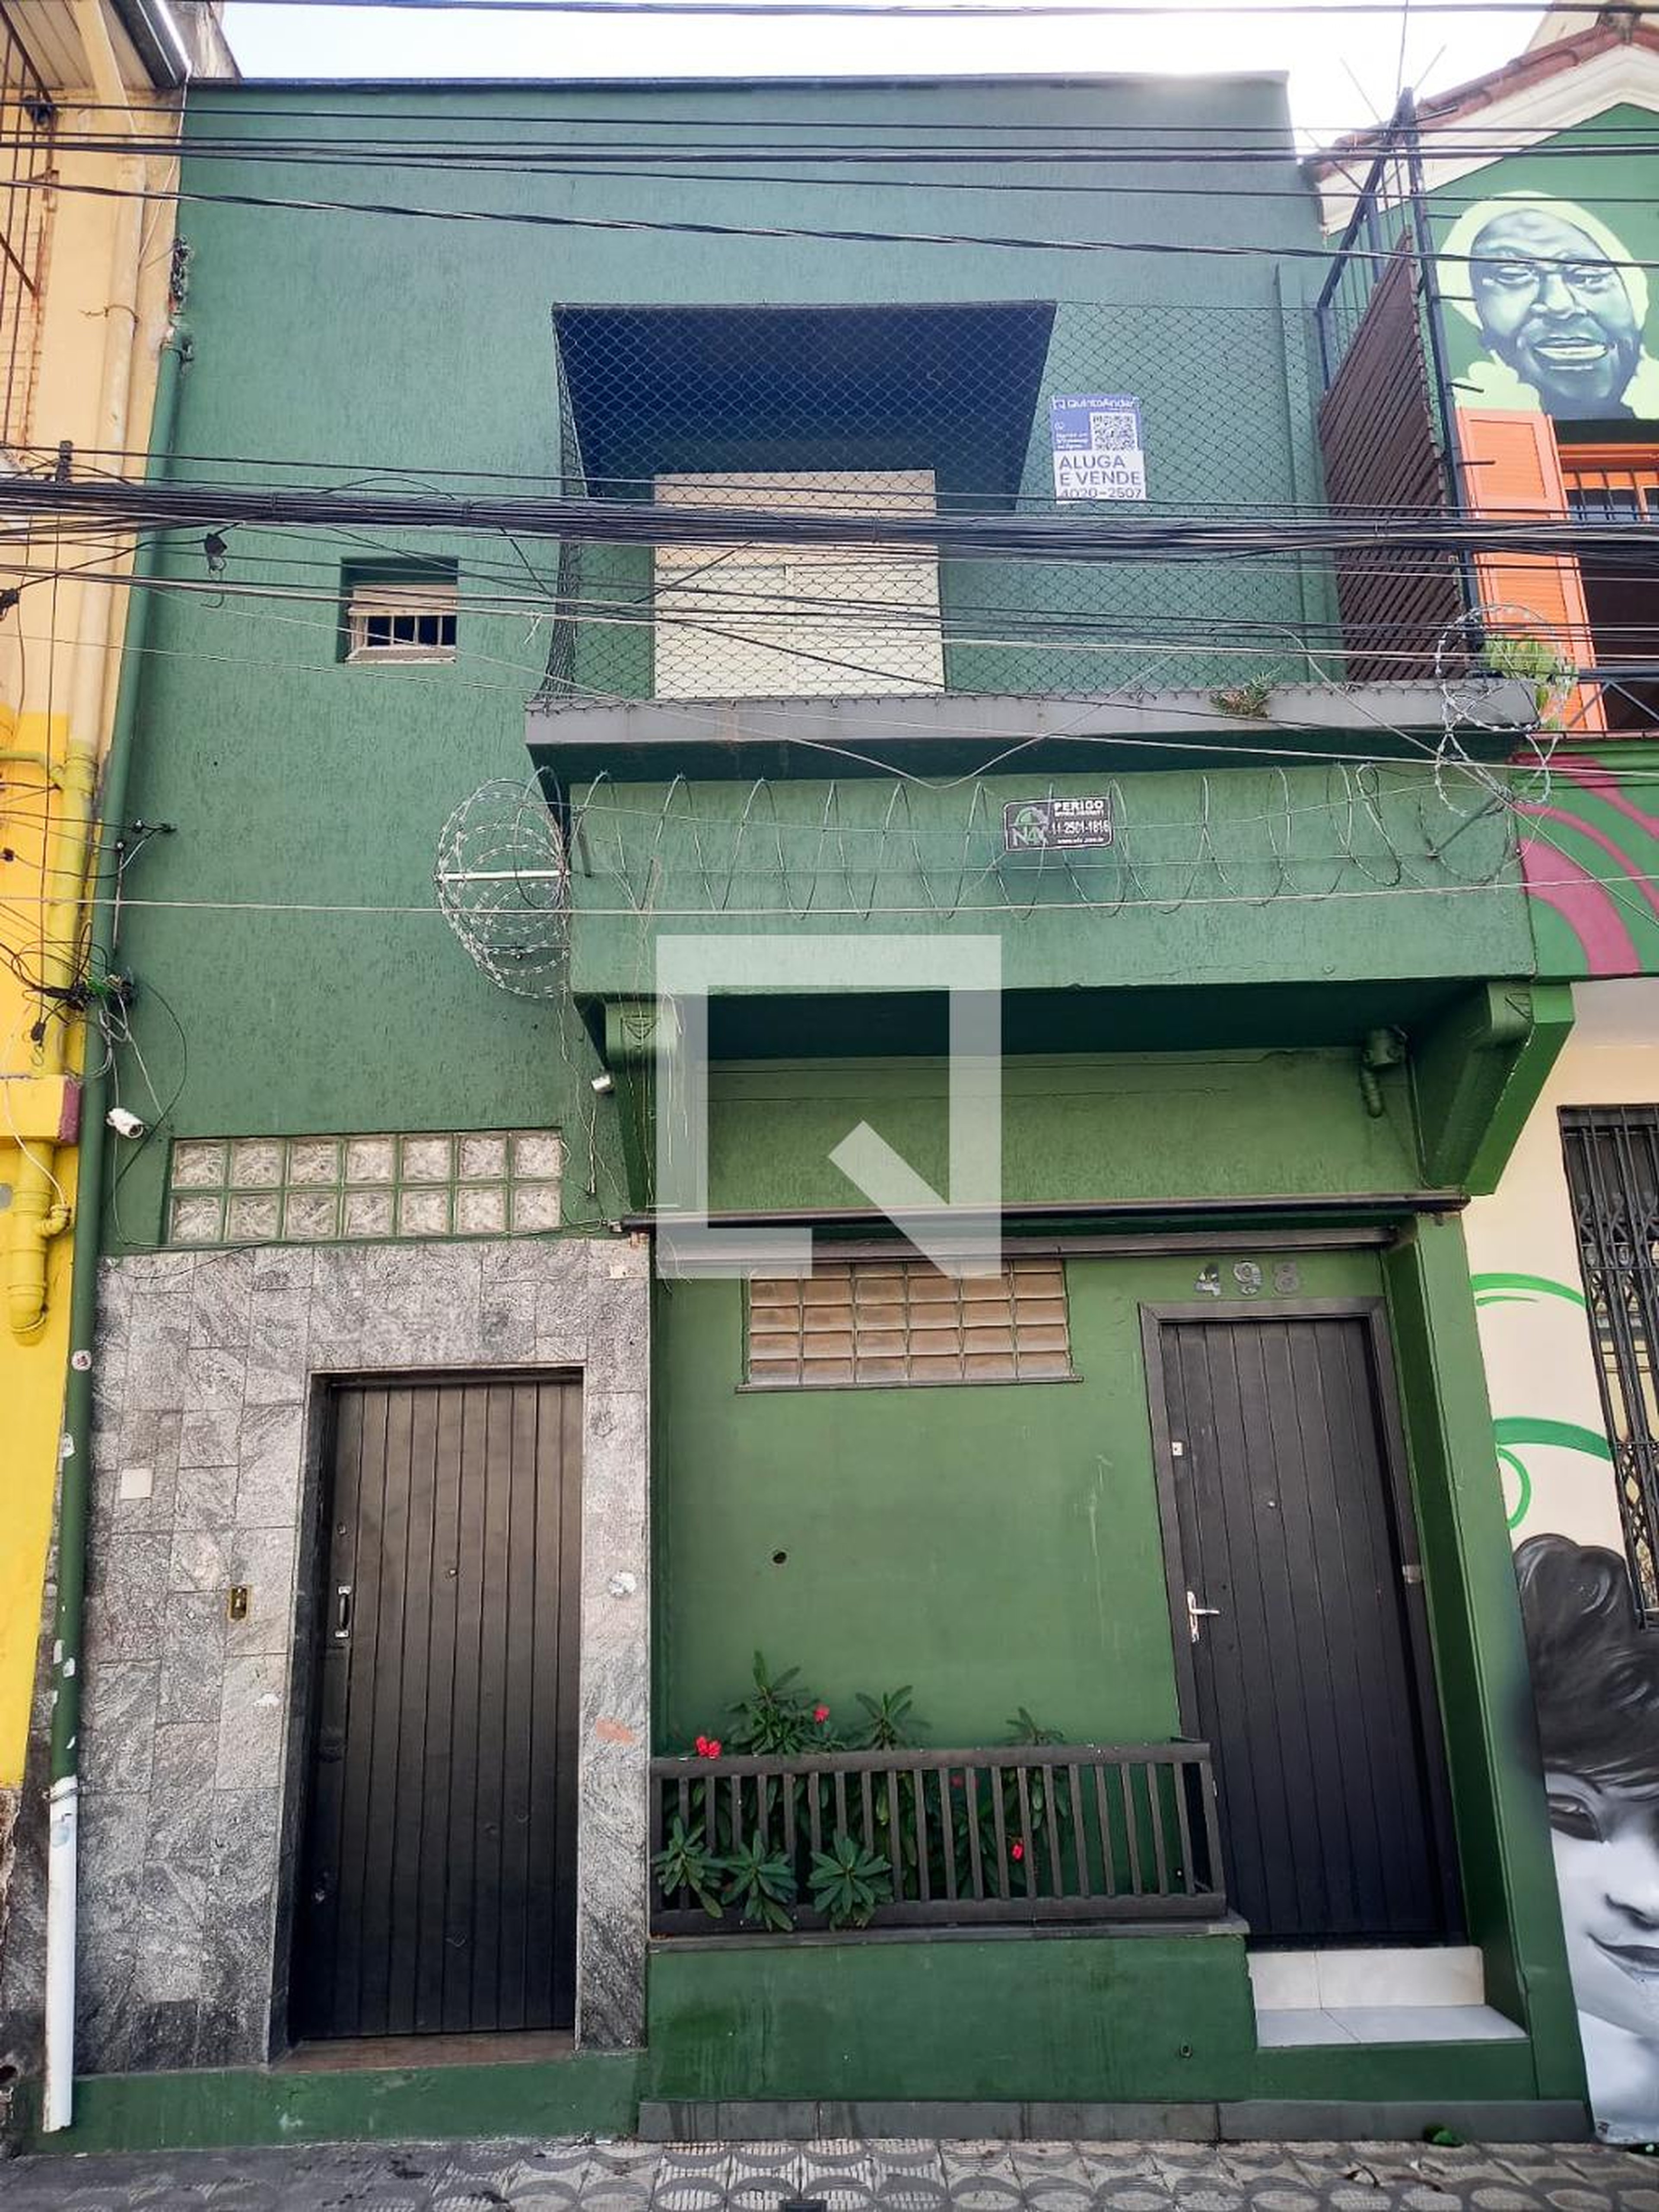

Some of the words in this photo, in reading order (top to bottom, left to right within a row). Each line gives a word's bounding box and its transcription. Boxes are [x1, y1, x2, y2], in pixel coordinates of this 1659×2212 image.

[1059, 455, 1125, 470] ALUGA
[1060, 472, 1070, 486] E
[1076, 471, 1141, 485] VENDE
[1061, 487, 1141, 498] 4020-2507
[1054, 800, 1104, 811] PERIGO
